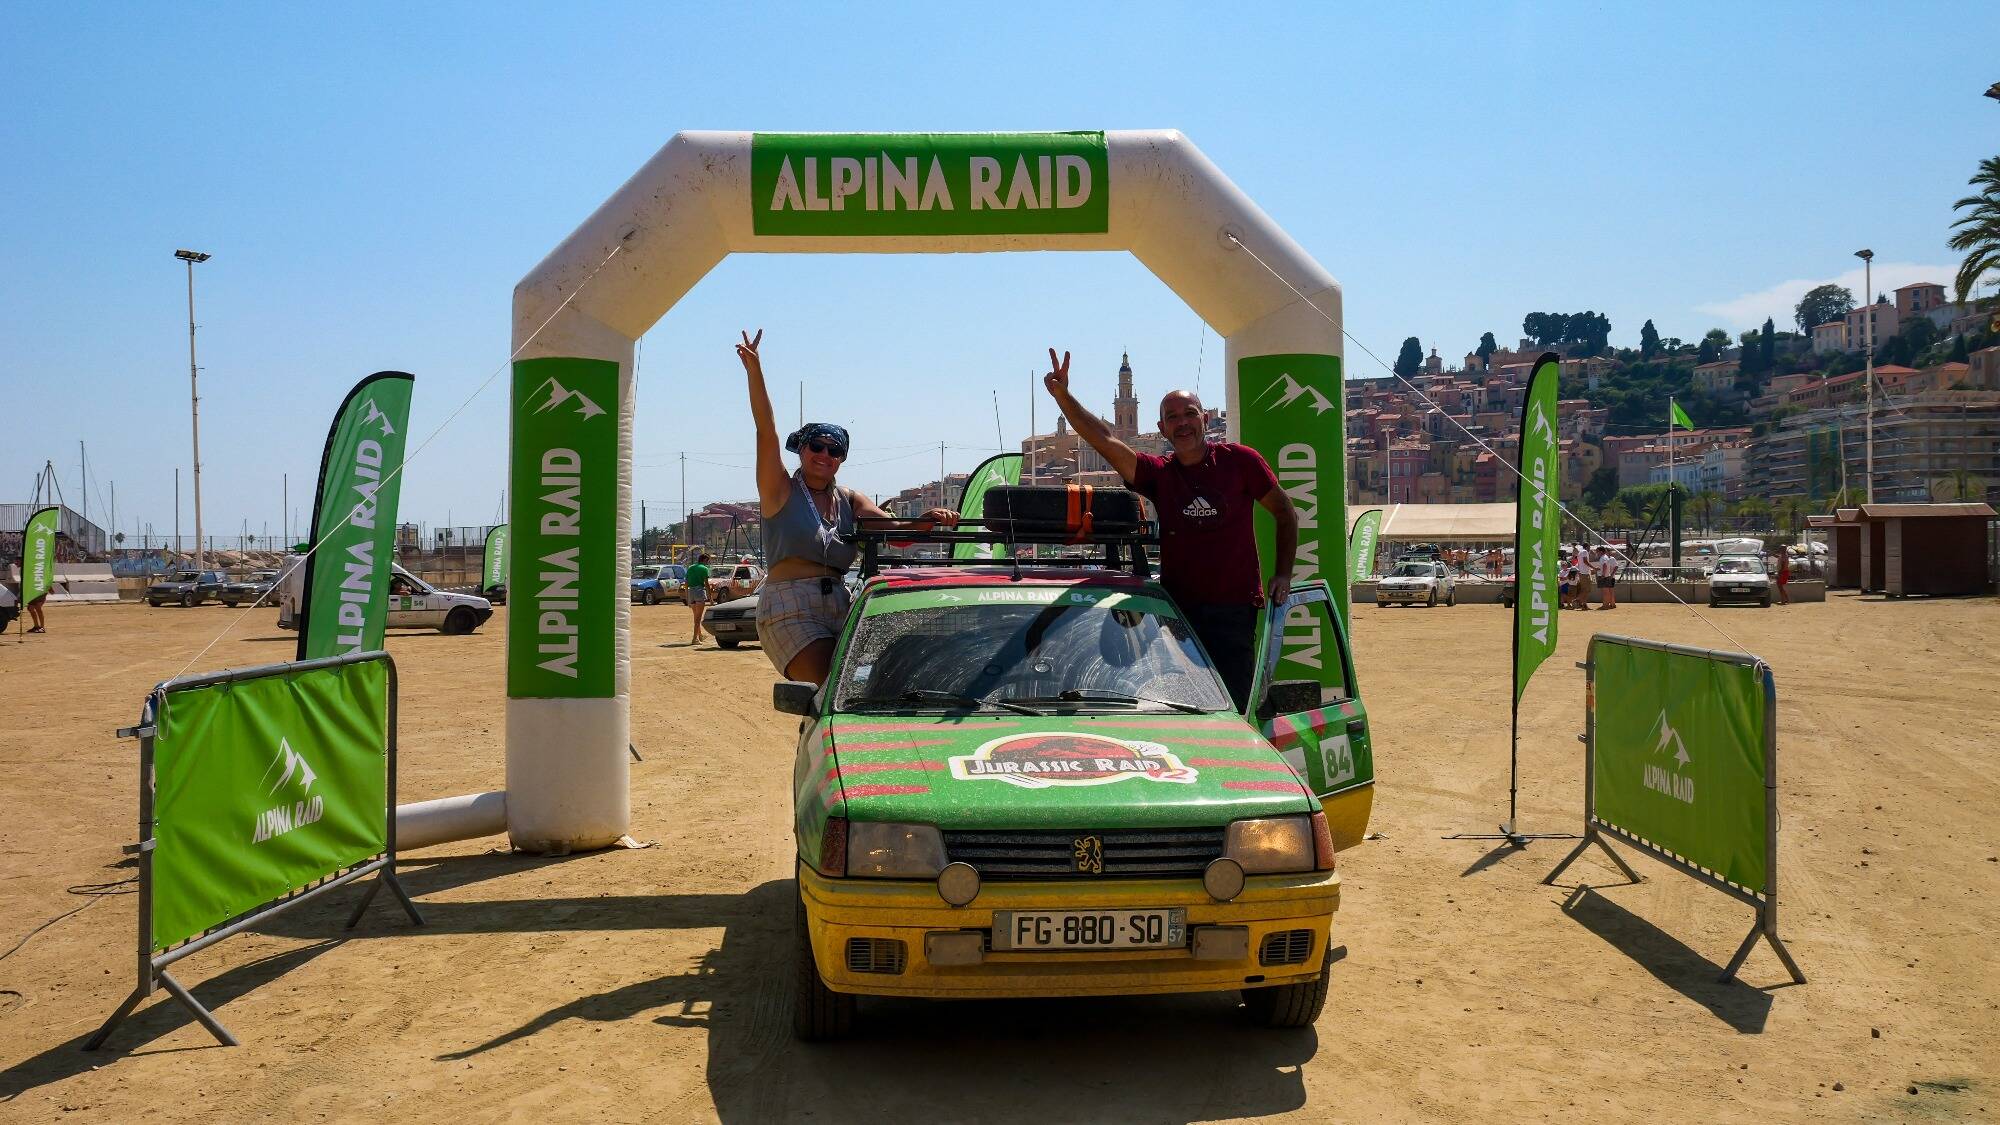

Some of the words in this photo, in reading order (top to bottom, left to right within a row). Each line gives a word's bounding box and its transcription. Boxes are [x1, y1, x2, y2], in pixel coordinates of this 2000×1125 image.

[770, 150, 954, 211] ALPINA
[969, 153, 1092, 209] RAID
[351, 439, 384, 529] RAID
[539, 448, 582, 535] RAID
[1532, 456, 1546, 530] RAID
[1183, 508, 1217, 516] adidas
[35, 539, 46, 560] RAID
[1361, 525, 1373, 546] RAID
[32, 560, 45, 592] ALPINA
[1356, 546, 1369, 577] ALPINA
[337, 540, 374, 654] LPINA
[533, 547, 580, 679] ALPINA
[978, 591, 1025, 601] ALPINA
[1027, 591, 1059, 601] RAID
[1071, 593, 1097, 604] 84
[1280, 540, 1322, 670] ALPA
[1531, 539, 1549, 646] ALPINA
[1325, 745, 1351, 779] 84
[1643, 762, 1672, 797] ALPINA
[1673, 772, 1694, 804] RAID
[252, 804, 293, 845] ALPINA
[295, 795, 324, 829] RAID
[1017, 915, 1163, 945] FG-880-SQ
[1169, 928, 1184, 943] 57
